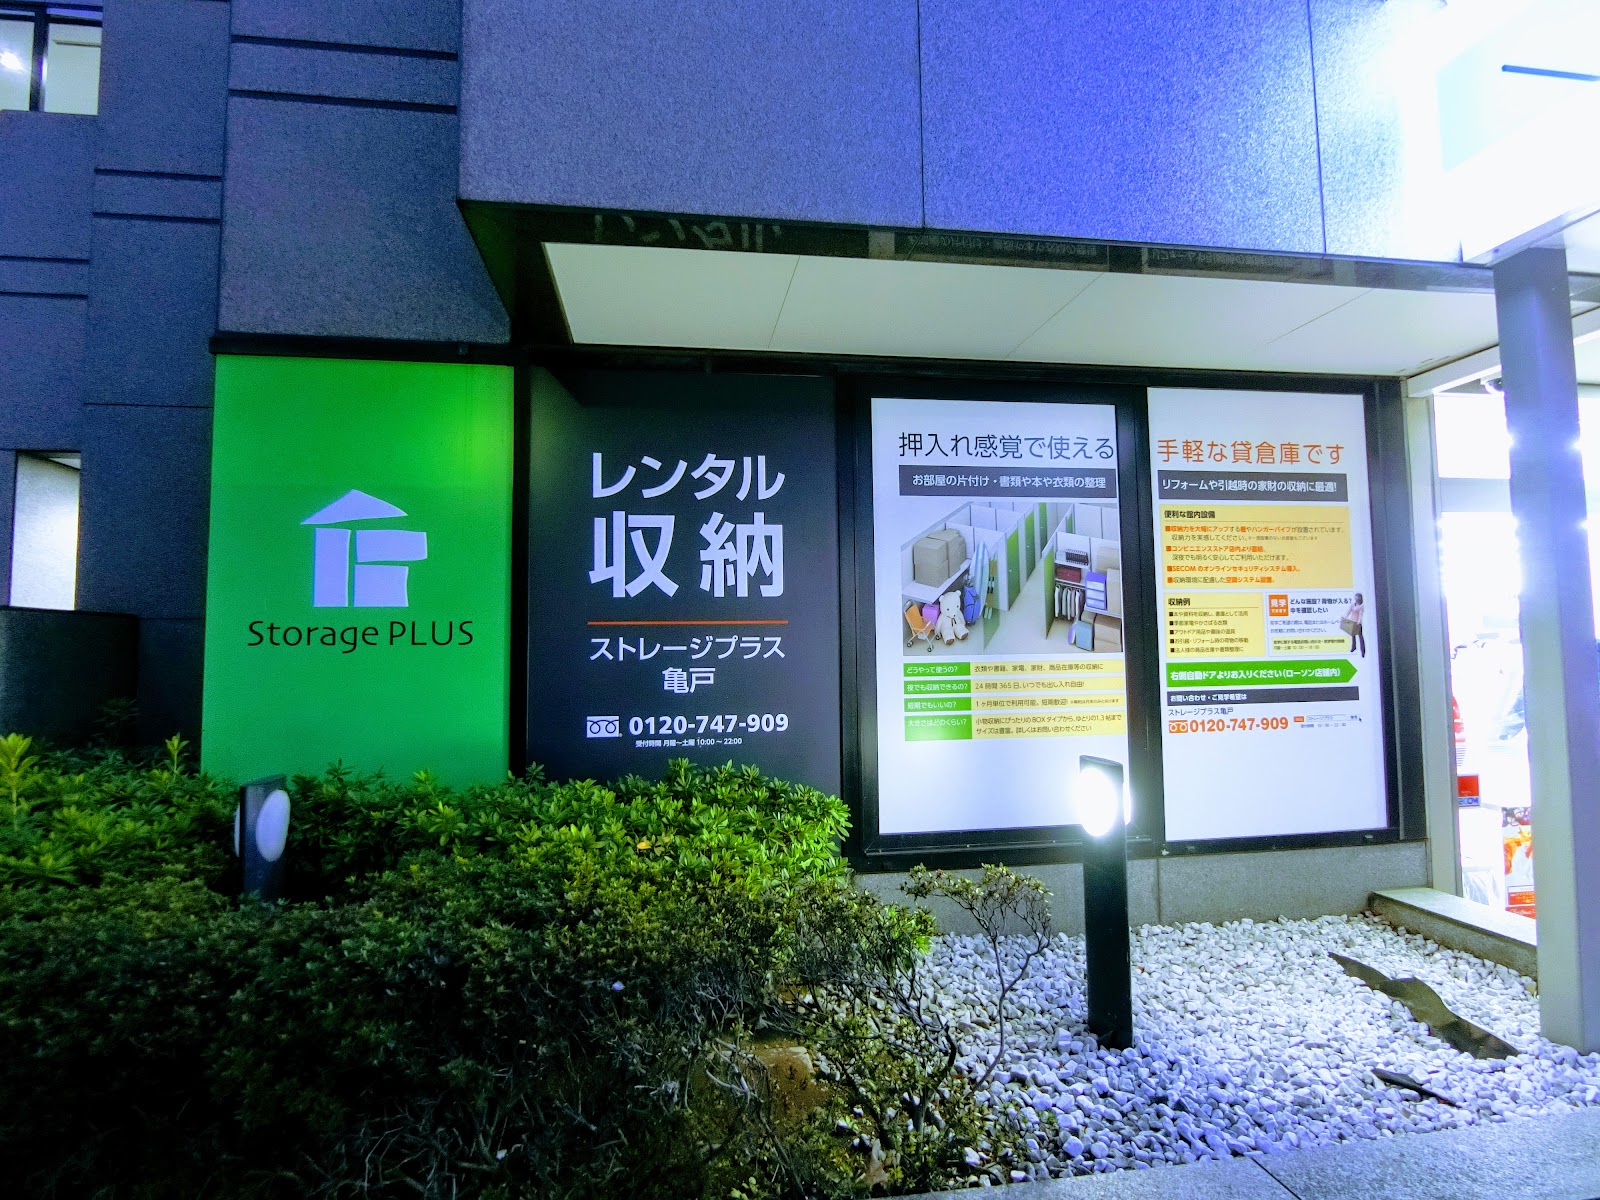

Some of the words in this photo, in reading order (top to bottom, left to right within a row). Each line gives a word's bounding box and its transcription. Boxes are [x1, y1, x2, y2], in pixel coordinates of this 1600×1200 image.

[899, 432, 1114, 459] 押入れ感覚で使える
[1157, 439, 1344, 465] 手軽な貸倉庫です
[592, 452, 785, 501] レンタル
[912, 474, 1106, 489] お部屋の片付け・書類や本や衣類の整理
[1162, 479, 1337, 493] リフォームや引越時の家財の収納に最適!
[1164, 510, 1216, 518] 便利な館内設備
[588, 511, 784, 598] 収納
[1168, 598, 1191, 606] 収納例
[248, 620, 379, 654] Storage
[390, 620, 473, 646] PLUS
[590, 635, 785, 661] ストレージプラス
[662, 667, 716, 694] 亀戸
[1168, 706, 1234, 717] ストレージプラス亀戸
[628, 713, 789, 736] 0120-747-909
[1189, 716, 1289, 733] 0120-747-909
[636, 740, 662, 748] 受付時間
[697, 738, 715, 746] 10:00
[724, 737, 742, 745] 22:00
